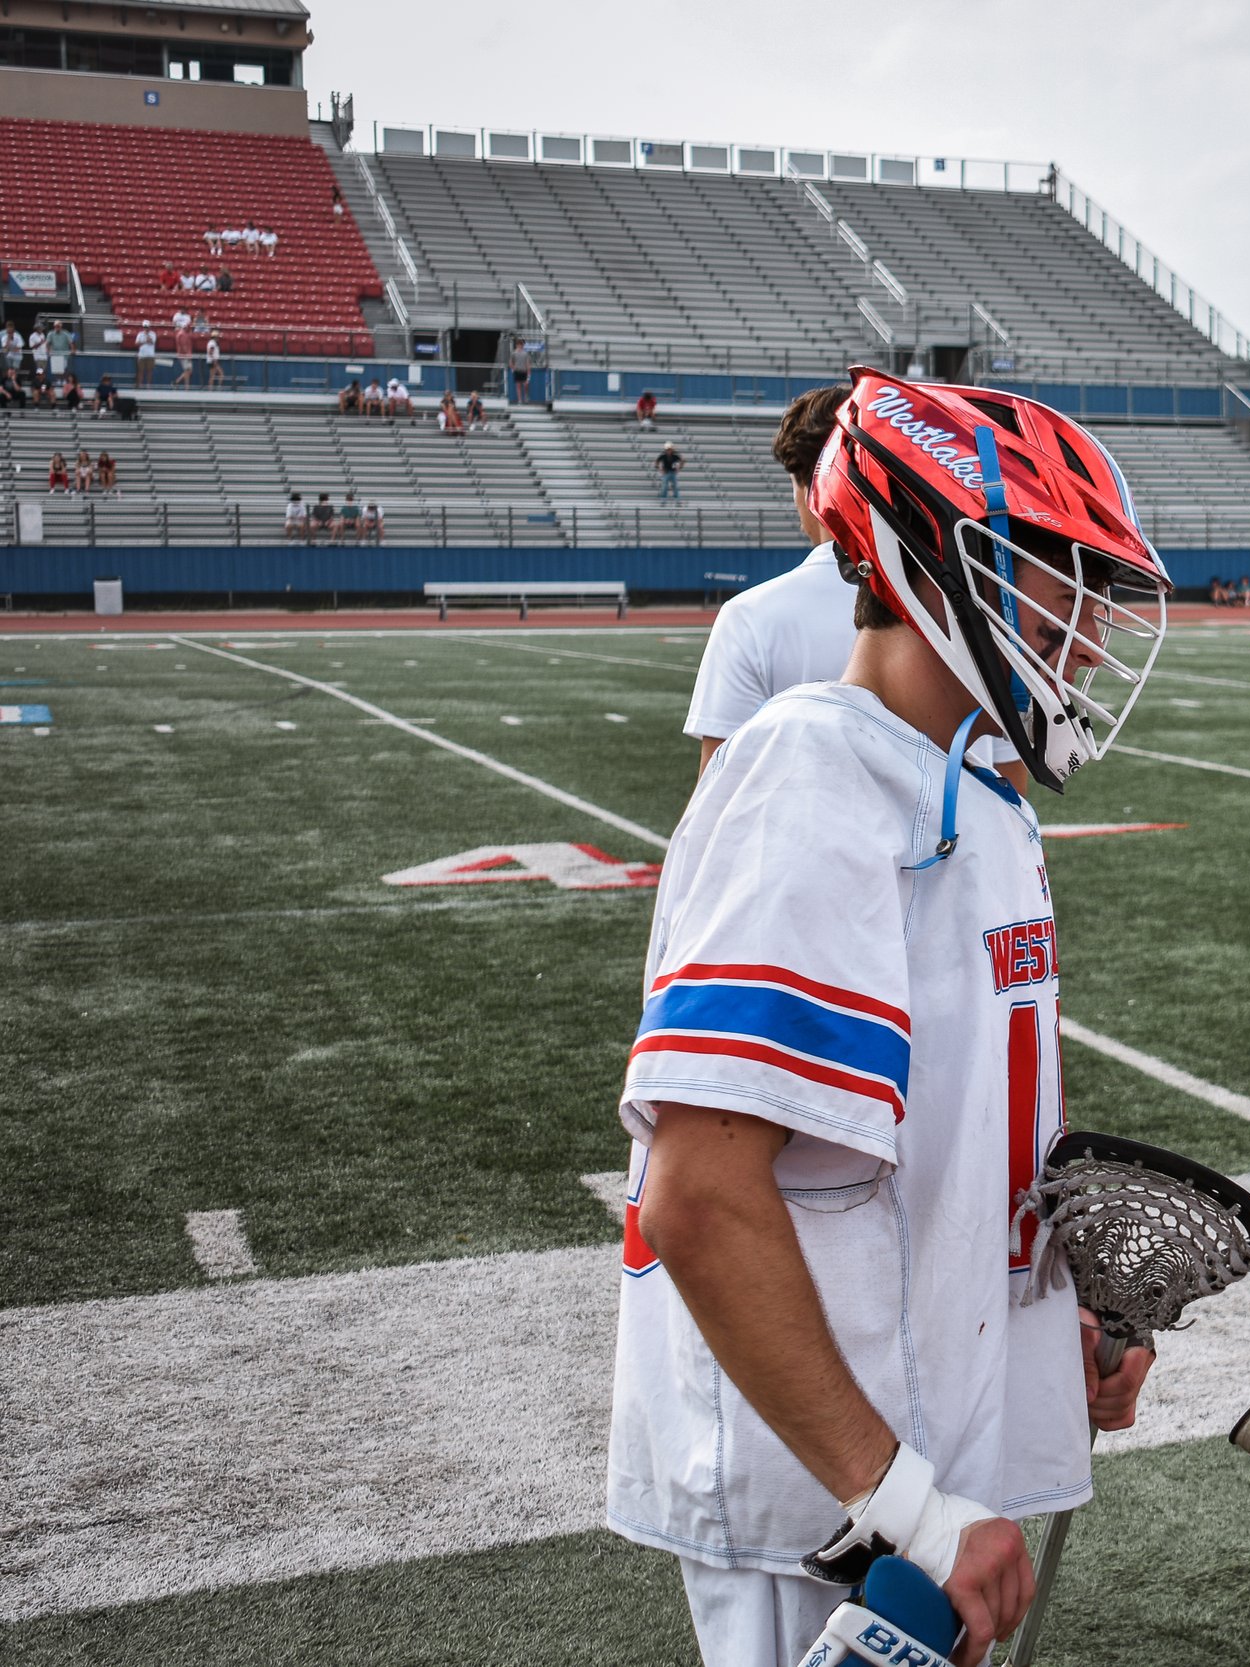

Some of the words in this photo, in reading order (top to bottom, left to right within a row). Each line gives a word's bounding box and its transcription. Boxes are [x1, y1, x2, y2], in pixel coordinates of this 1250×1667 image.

[867, 386, 984, 489] Westlake
[1014, 504, 1064, 528] XRS
[856, 1619, 955, 1667] BR
